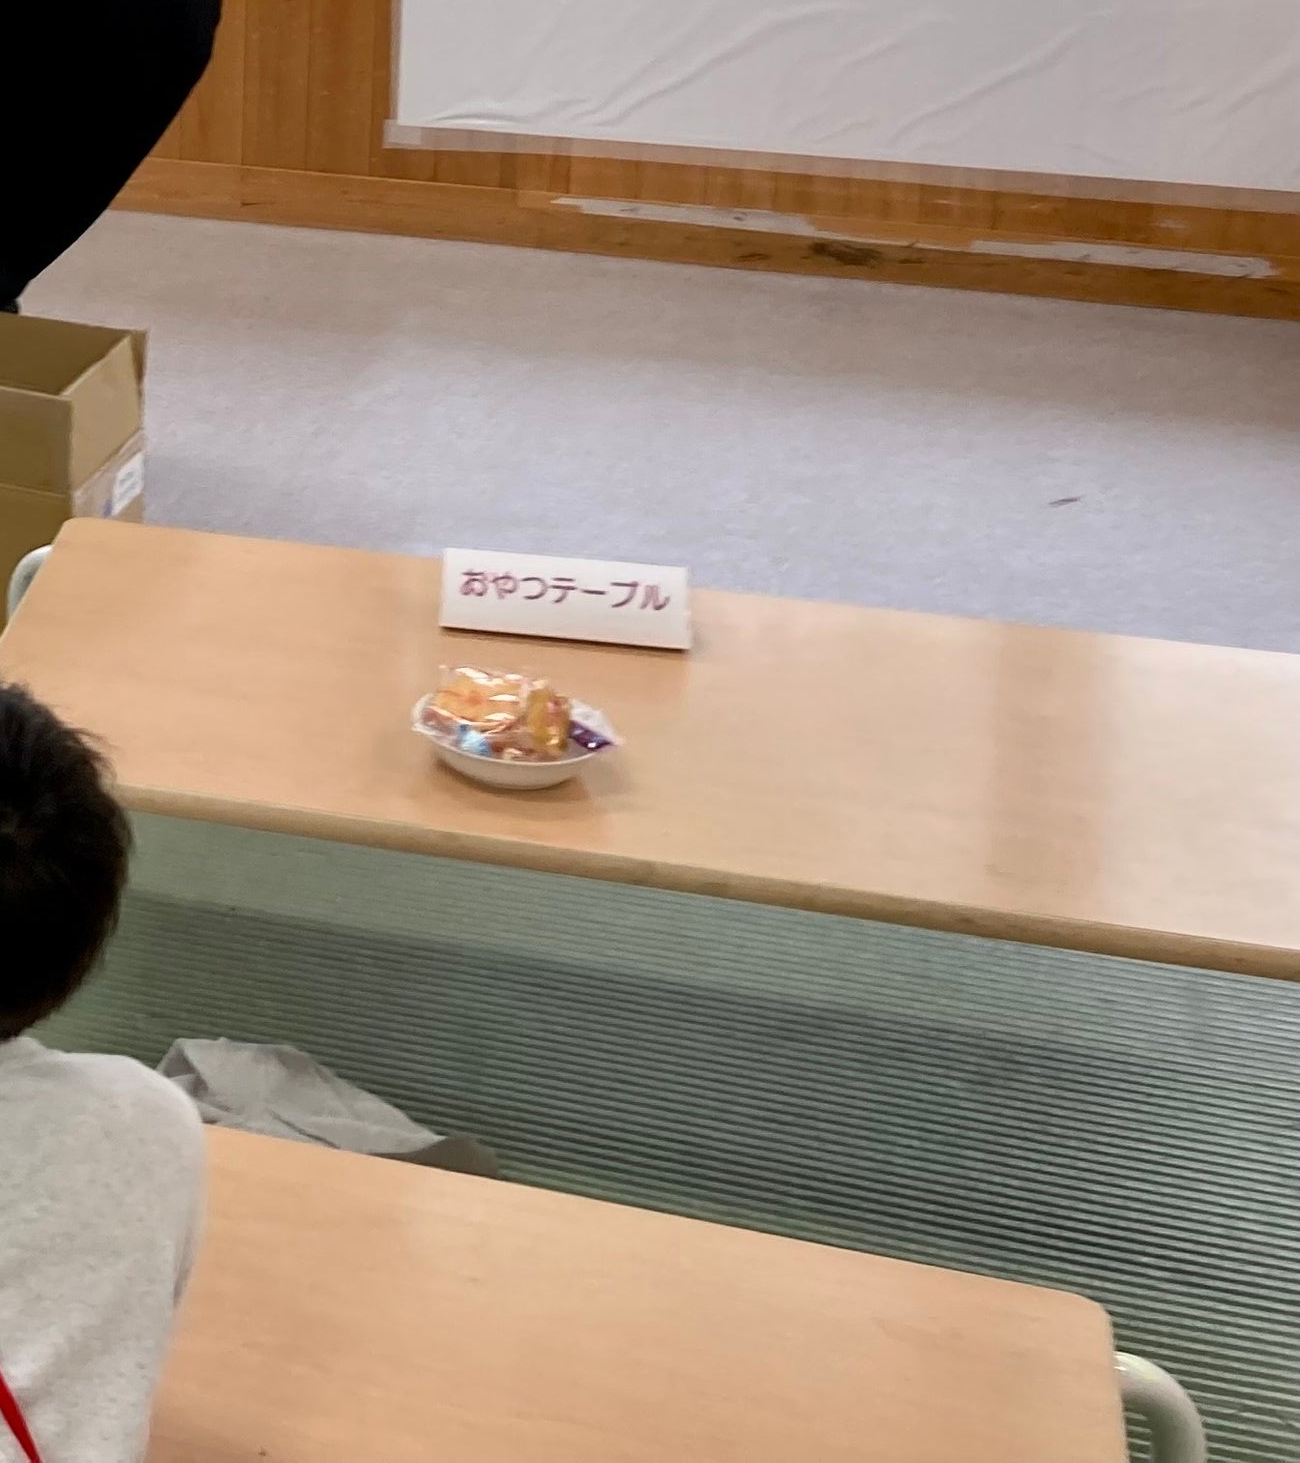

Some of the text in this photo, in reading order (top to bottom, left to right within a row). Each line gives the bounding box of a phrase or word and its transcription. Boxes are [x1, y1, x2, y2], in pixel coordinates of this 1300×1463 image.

[461, 569, 671, 611] おやつテーブル
